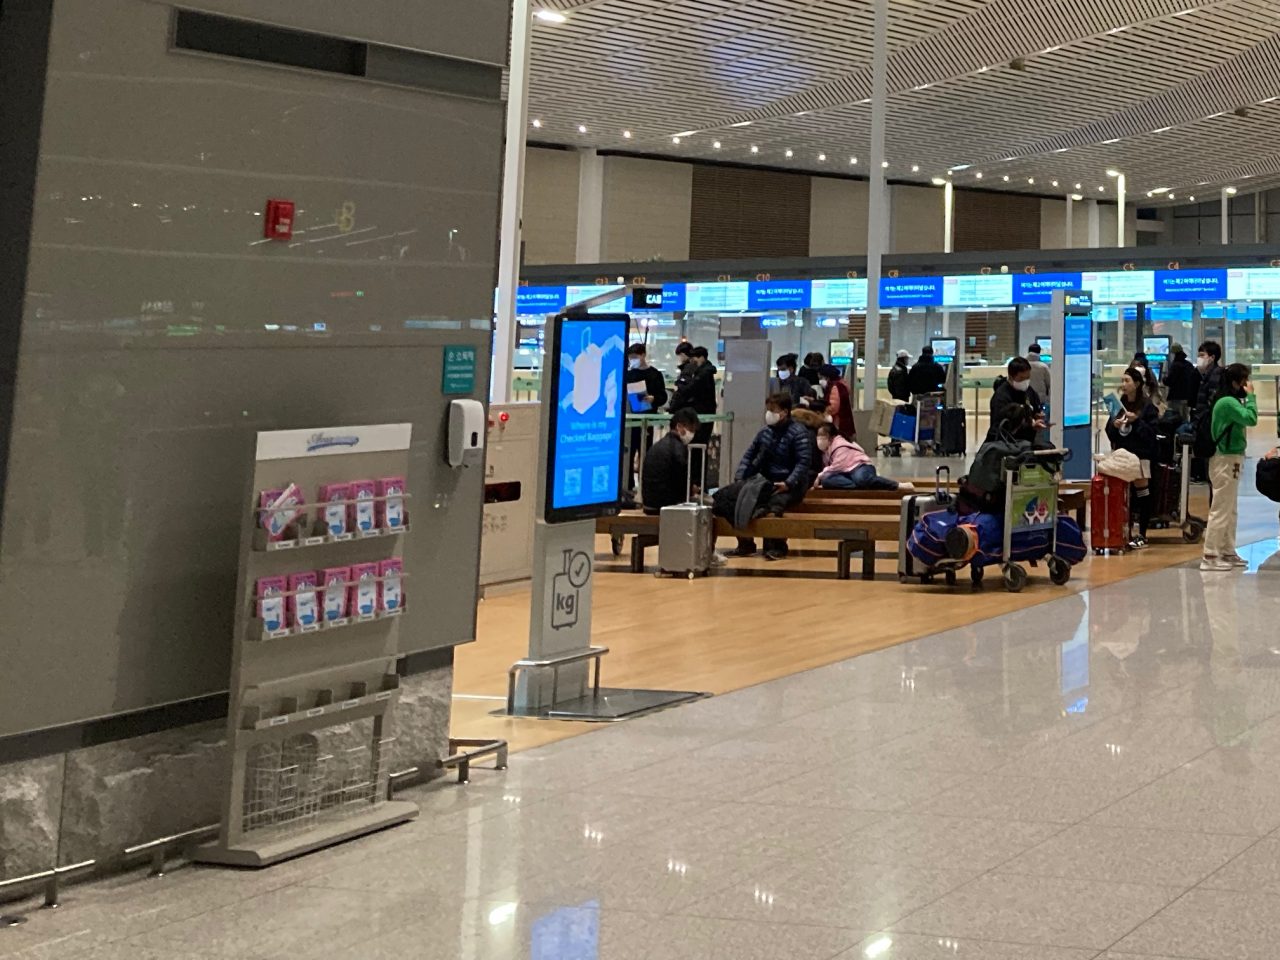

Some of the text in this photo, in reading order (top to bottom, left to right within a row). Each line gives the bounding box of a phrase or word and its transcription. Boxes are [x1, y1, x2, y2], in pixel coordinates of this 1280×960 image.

[1024, 266, 1036, 274] C6
[1123, 263, 1135, 271] C5
[556, 593, 575, 615] kg
